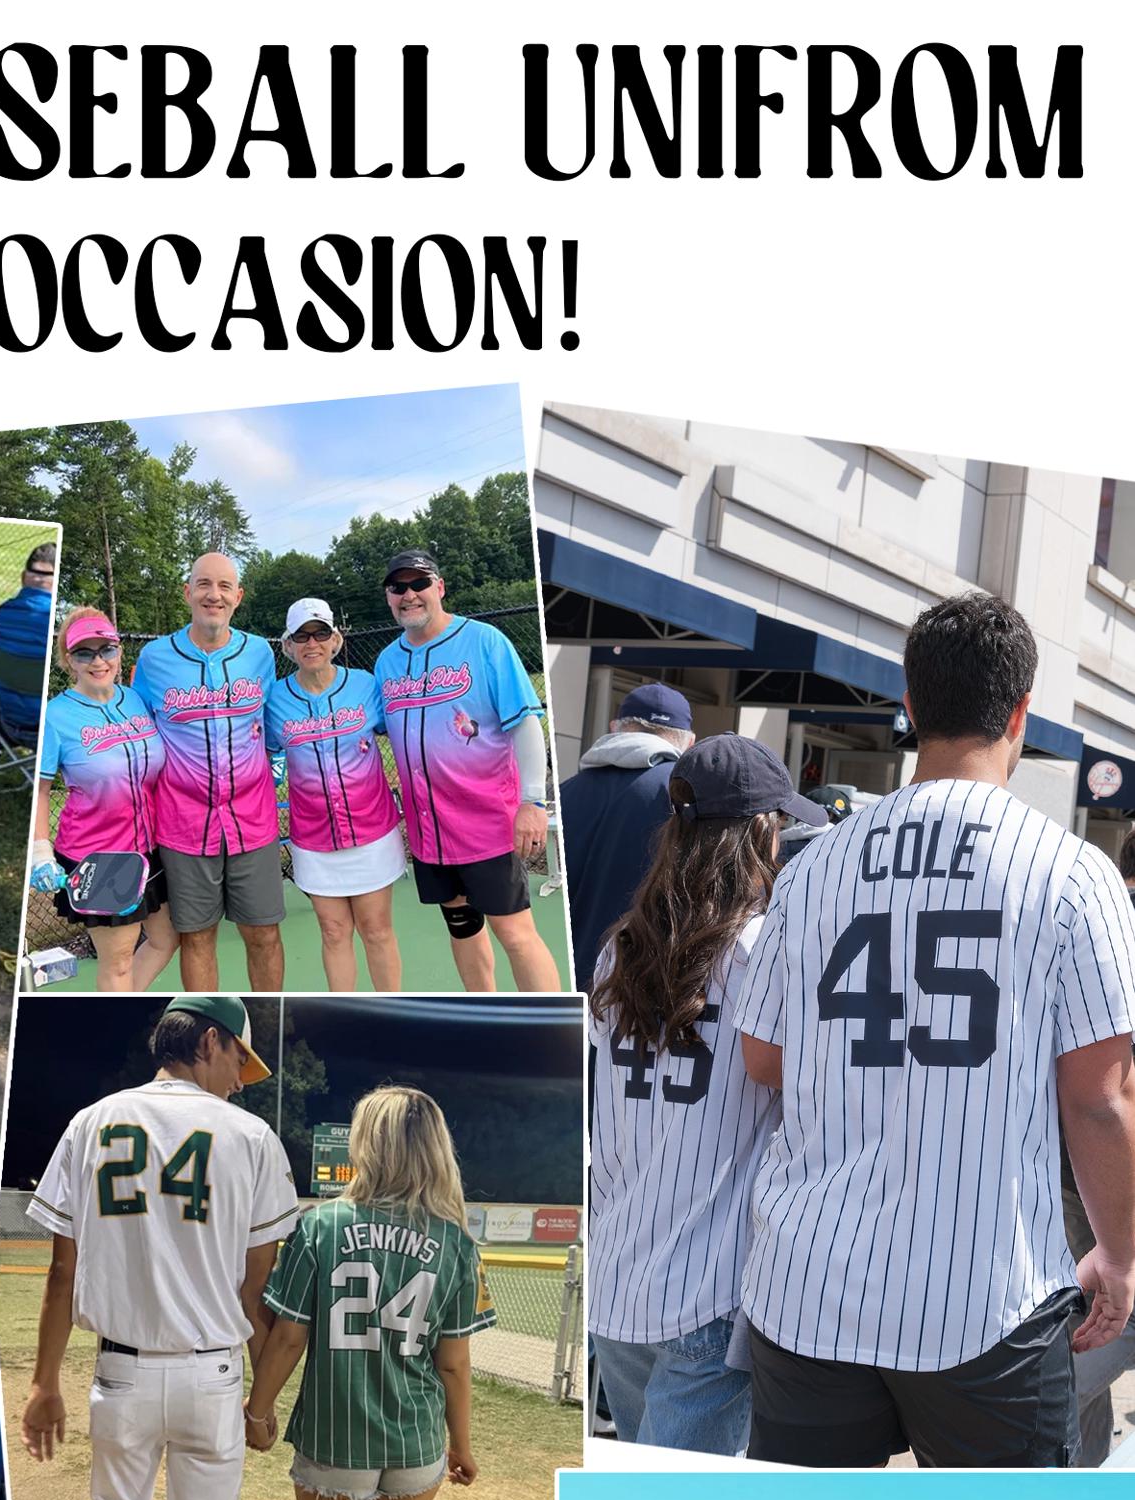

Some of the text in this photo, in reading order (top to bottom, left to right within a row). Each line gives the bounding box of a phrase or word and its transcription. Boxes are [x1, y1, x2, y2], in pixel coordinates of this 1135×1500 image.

[428, 662, 471, 692] Pink
[861, 820, 993, 883] COLE
[816, 909, 1002, 1069] 45
[96, 1121, 213, 1225] 24
[339, 1220, 441, 1265] JENKINS
[328, 1261, 438, 1357] 24
